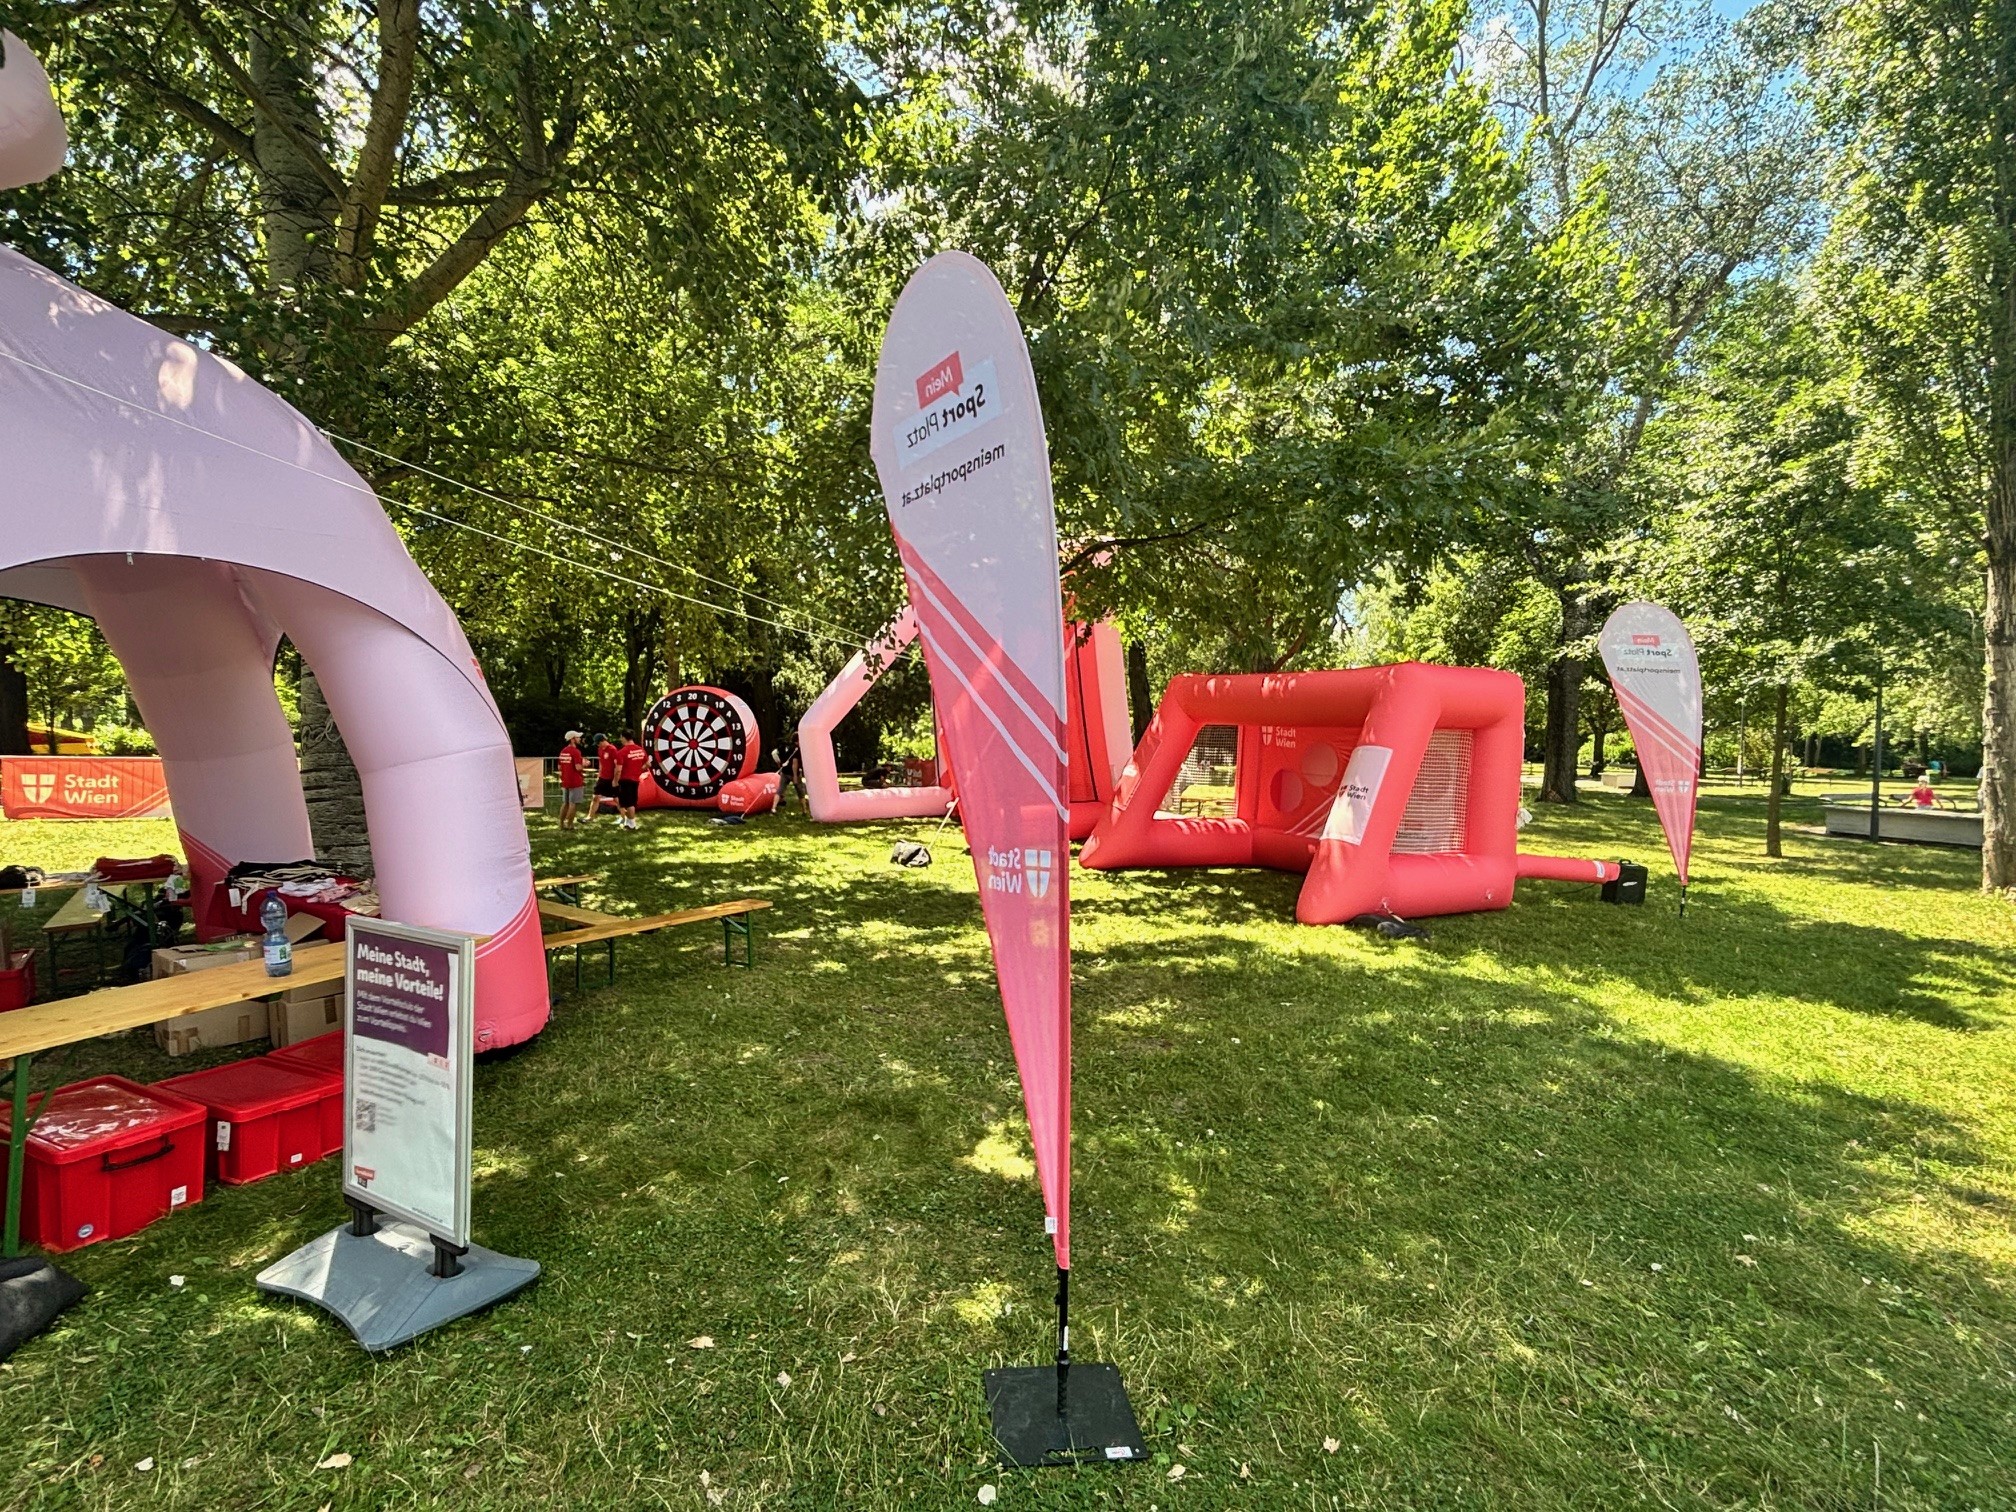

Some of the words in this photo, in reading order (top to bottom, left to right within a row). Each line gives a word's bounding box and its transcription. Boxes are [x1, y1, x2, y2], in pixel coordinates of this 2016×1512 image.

[688, 692, 698, 700] 20
[1276, 727, 1296, 737] Stadt
[1276, 738, 1296, 748] Wien
[652, 768, 660, 776] 16
[64, 774, 119, 788] Stadt
[1349, 785, 1369, 793] Stadt
[63, 789, 119, 804] Wien
[1347, 792, 1366, 800] Wien
[357, 943, 393, 966] Meine
[394, 951, 430, 977] Stadt,
[357, 968, 393, 987] meine
[394, 972, 444, 1001] Vorteile!
